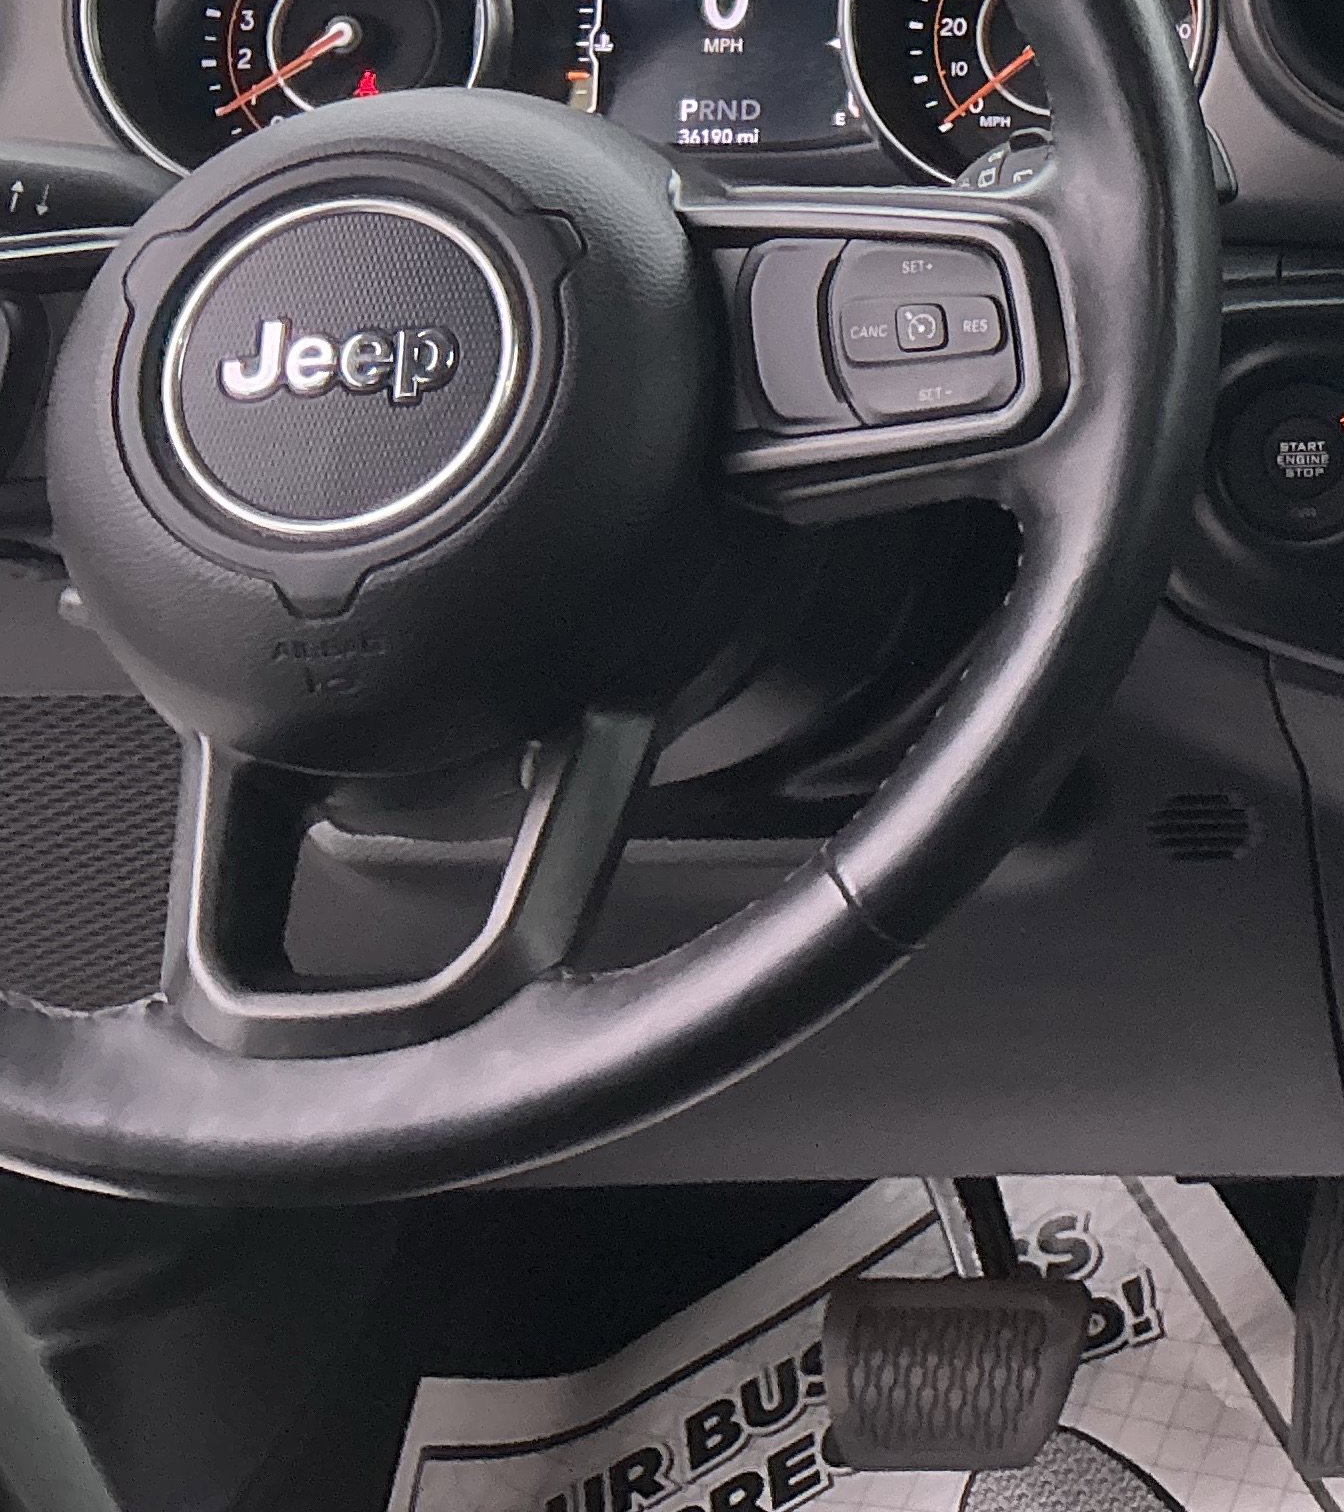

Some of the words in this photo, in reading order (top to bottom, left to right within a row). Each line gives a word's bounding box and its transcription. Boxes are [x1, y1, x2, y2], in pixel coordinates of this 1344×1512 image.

[240, 10, 255, 31] 3
[940, 17, 967, 37] 20
[704, 38, 743, 53] MPH
[237, 48, 253, 69] 2
[951, 61, 968, 77] 10
[834, 112, 846, 126] E
[979, 115, 1011, 128] MPH
[677, 128, 732, 145] 36190
[737, 128, 759, 144] mi
[850, 325, 888, 339] CANC
[963, 319, 988, 333] RES
[219, 317, 459, 405] Jeep
[1280, 441, 1326, 452] START
[1277, 454, 1329, 465] ENGINE
[1285, 467, 1324, 478] STOP
